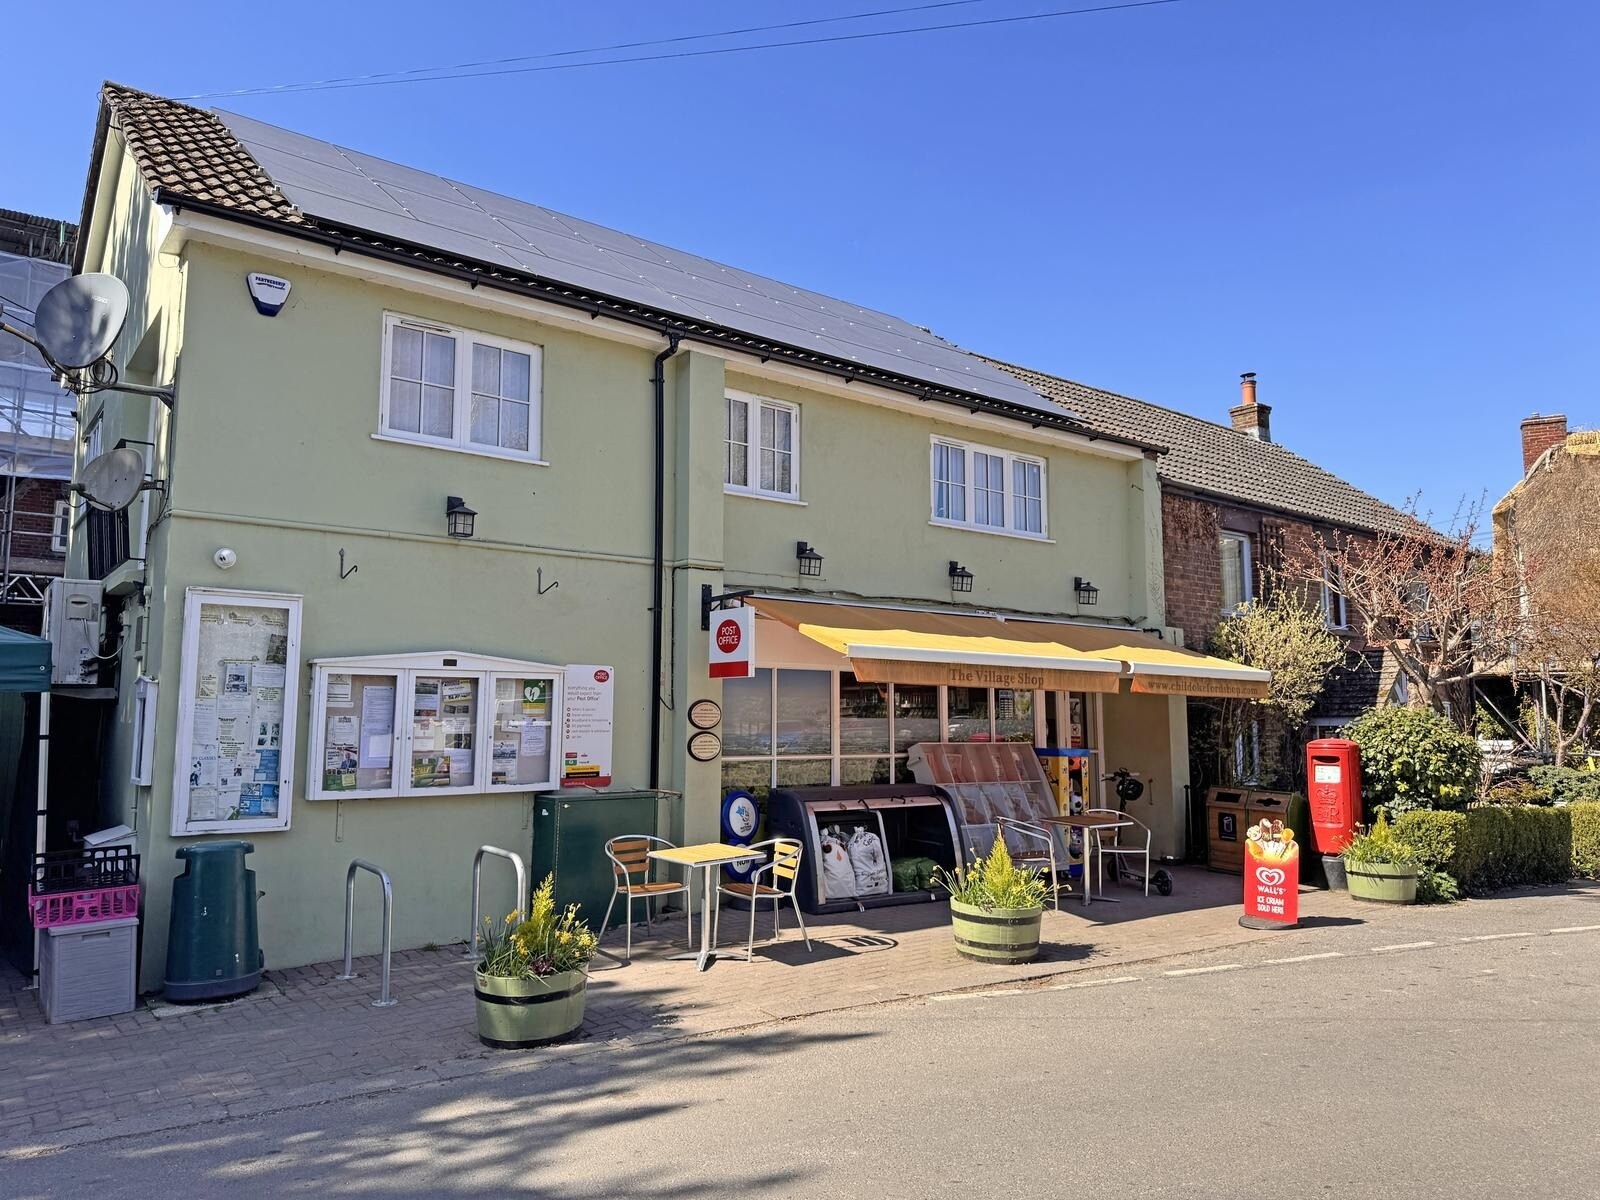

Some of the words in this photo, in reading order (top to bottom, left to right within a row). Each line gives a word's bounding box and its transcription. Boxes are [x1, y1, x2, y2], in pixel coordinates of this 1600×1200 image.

[721, 626, 737, 635] POST
[718, 635, 739, 645] OFFICE
[949, 668, 973, 681] The
[975, 669, 1015, 686] Village
[1017, 672, 1044, 688] Shop
[1257, 885, 1284, 895] WALL'S
[1257, 895, 1265, 904] ICE
[1266, 897, 1284, 906] CREAM
[1257, 904, 1271, 912] SOLD
[1272, 905, 1284, 914] HERE
